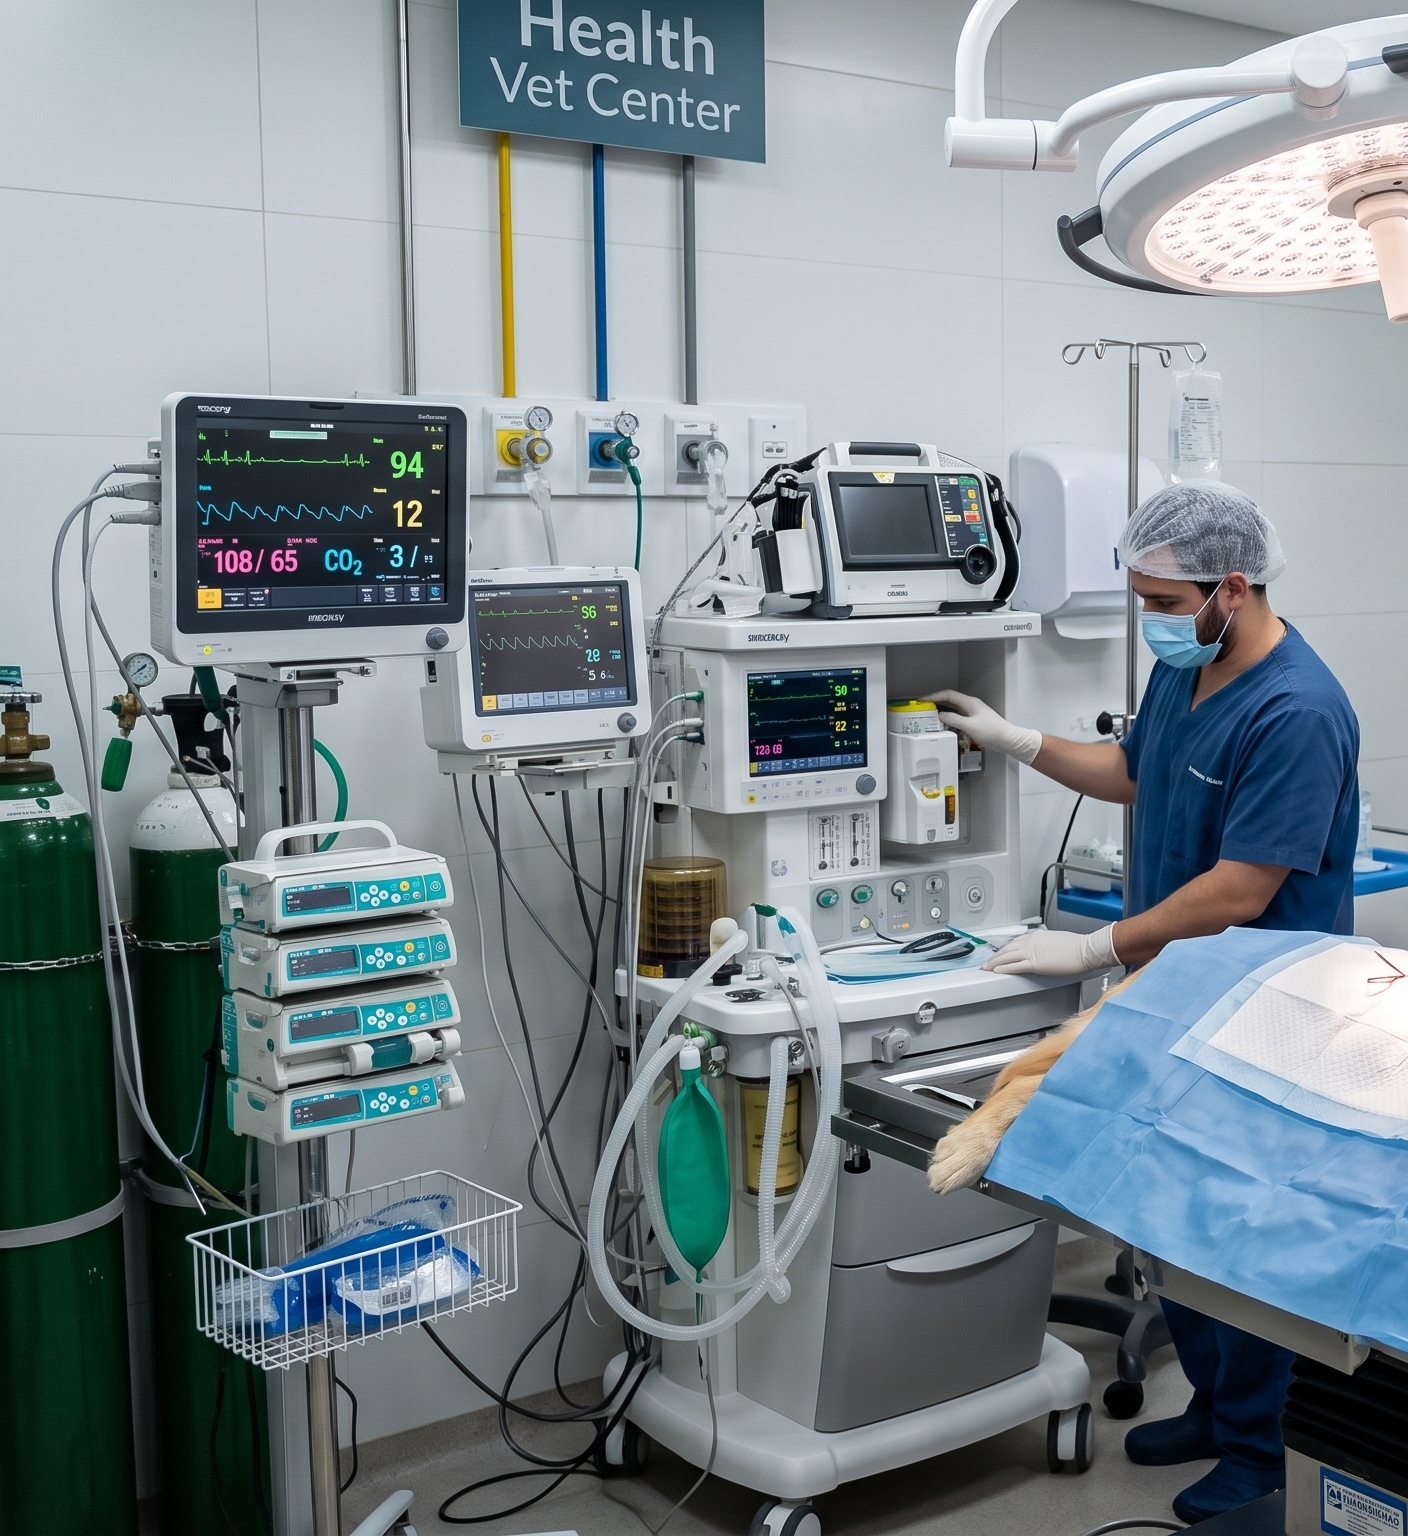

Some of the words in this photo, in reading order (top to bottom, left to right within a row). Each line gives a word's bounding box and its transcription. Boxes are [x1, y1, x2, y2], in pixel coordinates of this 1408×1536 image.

[520, 0, 714, 75] Health
[489, 56, 574, 112] Vet
[586, 72, 741, 133] Center
[390, 451, 424, 479] 94
[392, 500, 423, 528] 12
